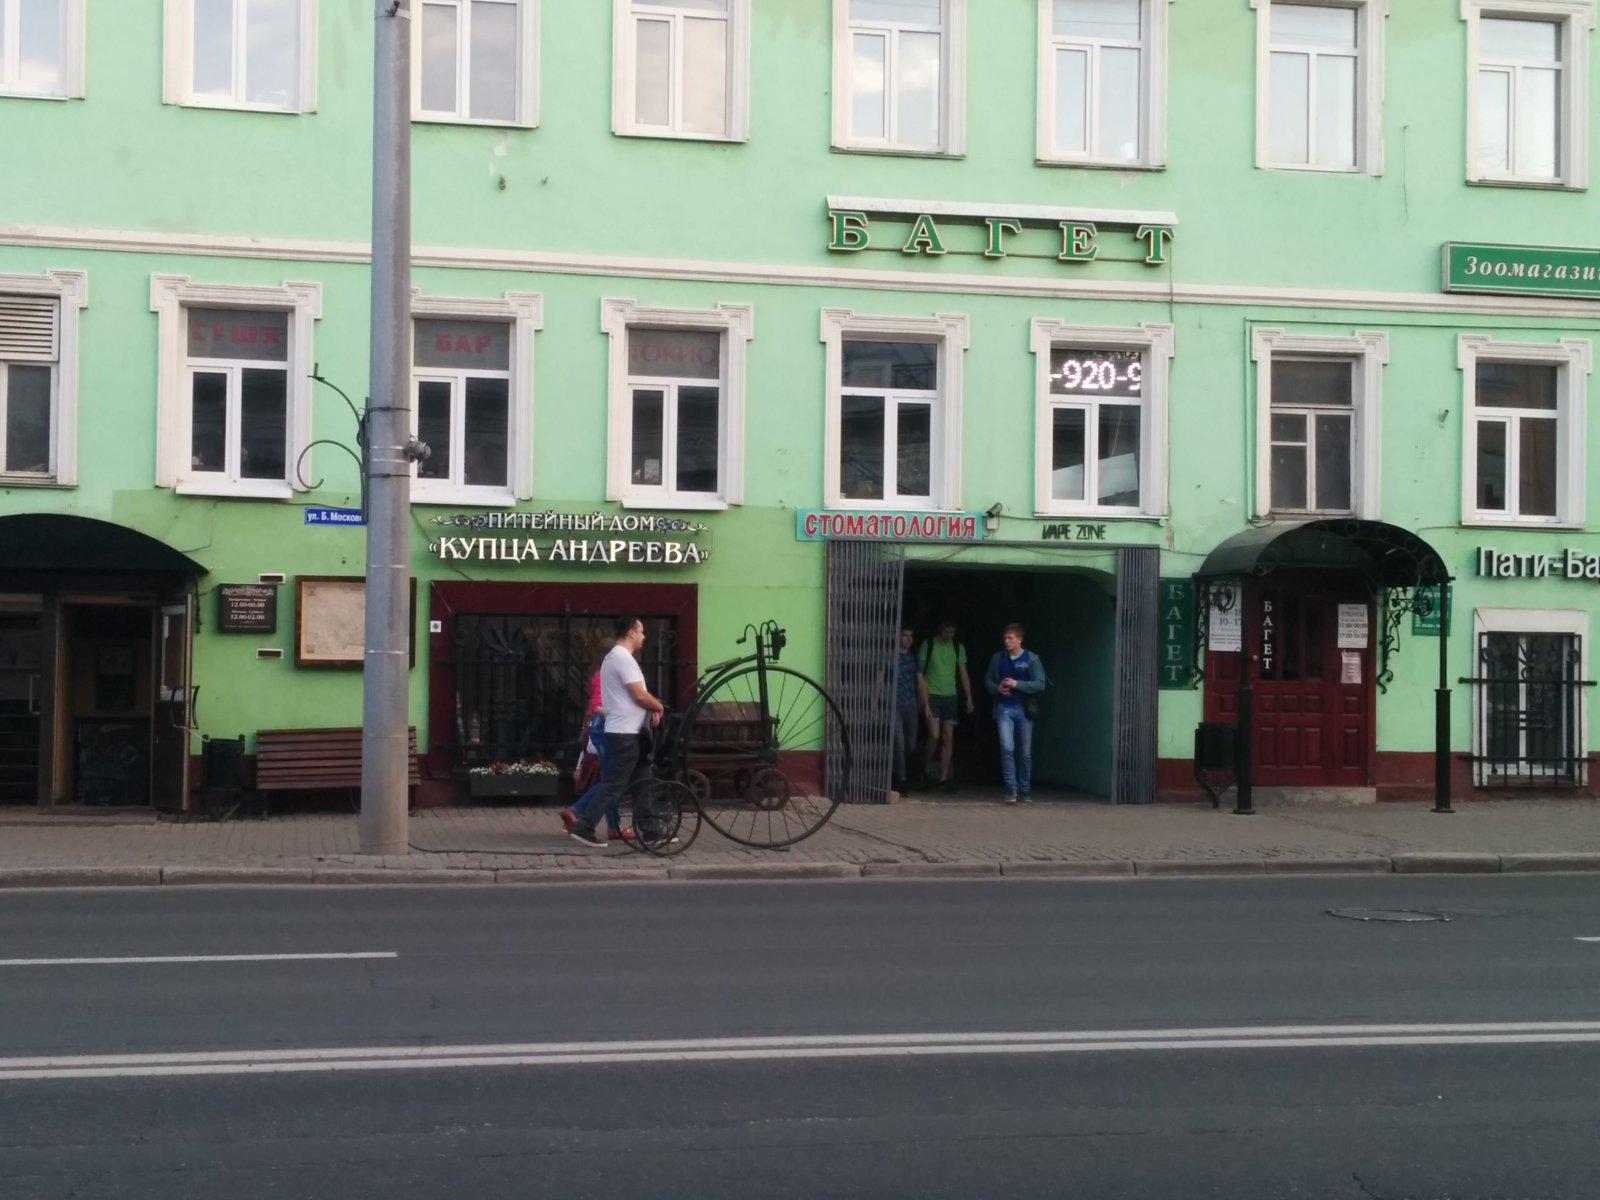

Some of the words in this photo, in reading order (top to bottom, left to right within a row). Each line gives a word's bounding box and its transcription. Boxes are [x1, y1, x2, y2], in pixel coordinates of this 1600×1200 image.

[828, 210, 1176, 265] БАГЕТ
[435, 333, 491, 353] БАР
[307, 513, 320, 522] ул.
[321, 511, 329, 521] Б.
[488, 510, 604, 532] ПИТЕЙНЫЙ
[609, 514, 655, 532] ДОМ
[804, 511, 977, 537] СТОМАТОЛОГИЯ
[1041, 524, 1071, 540] VAPE
[1076, 524, 1107, 540] ZONE
[429, 537, 540, 564] «КУПЦА
[549, 539, 709, 565] АНДРЕЕВА»
[1165, 584, 1184, 681] БАГЕТ
[1263, 601, 1273, 670] БАГЕТ
